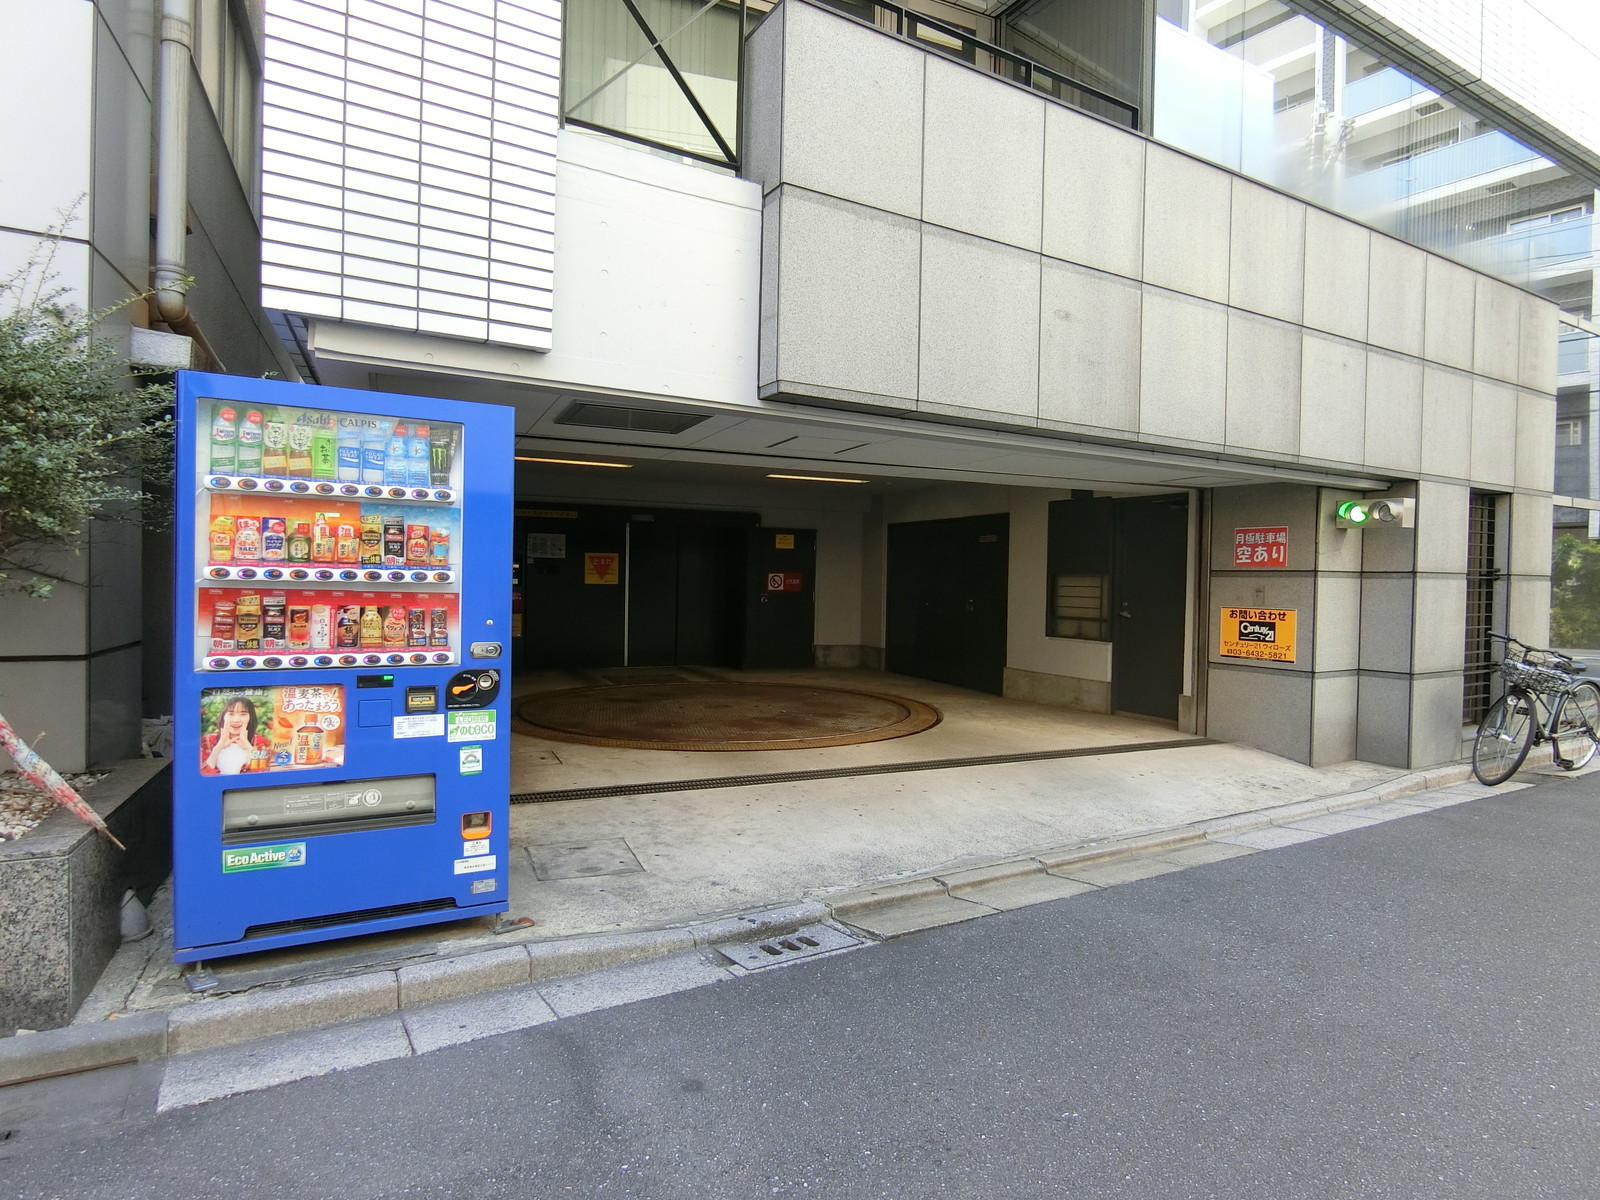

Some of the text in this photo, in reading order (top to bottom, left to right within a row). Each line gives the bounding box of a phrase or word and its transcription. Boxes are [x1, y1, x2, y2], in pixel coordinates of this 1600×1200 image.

[340, 417, 377, 429] CALPIS
[1236, 532, 1287, 545] 月極駐車場
[1236, 545, 1284, 563] 空あり
[1229, 610, 1287, 622] お問い合わせ
[1232, 648, 1287, 660] 03-6432-5821
